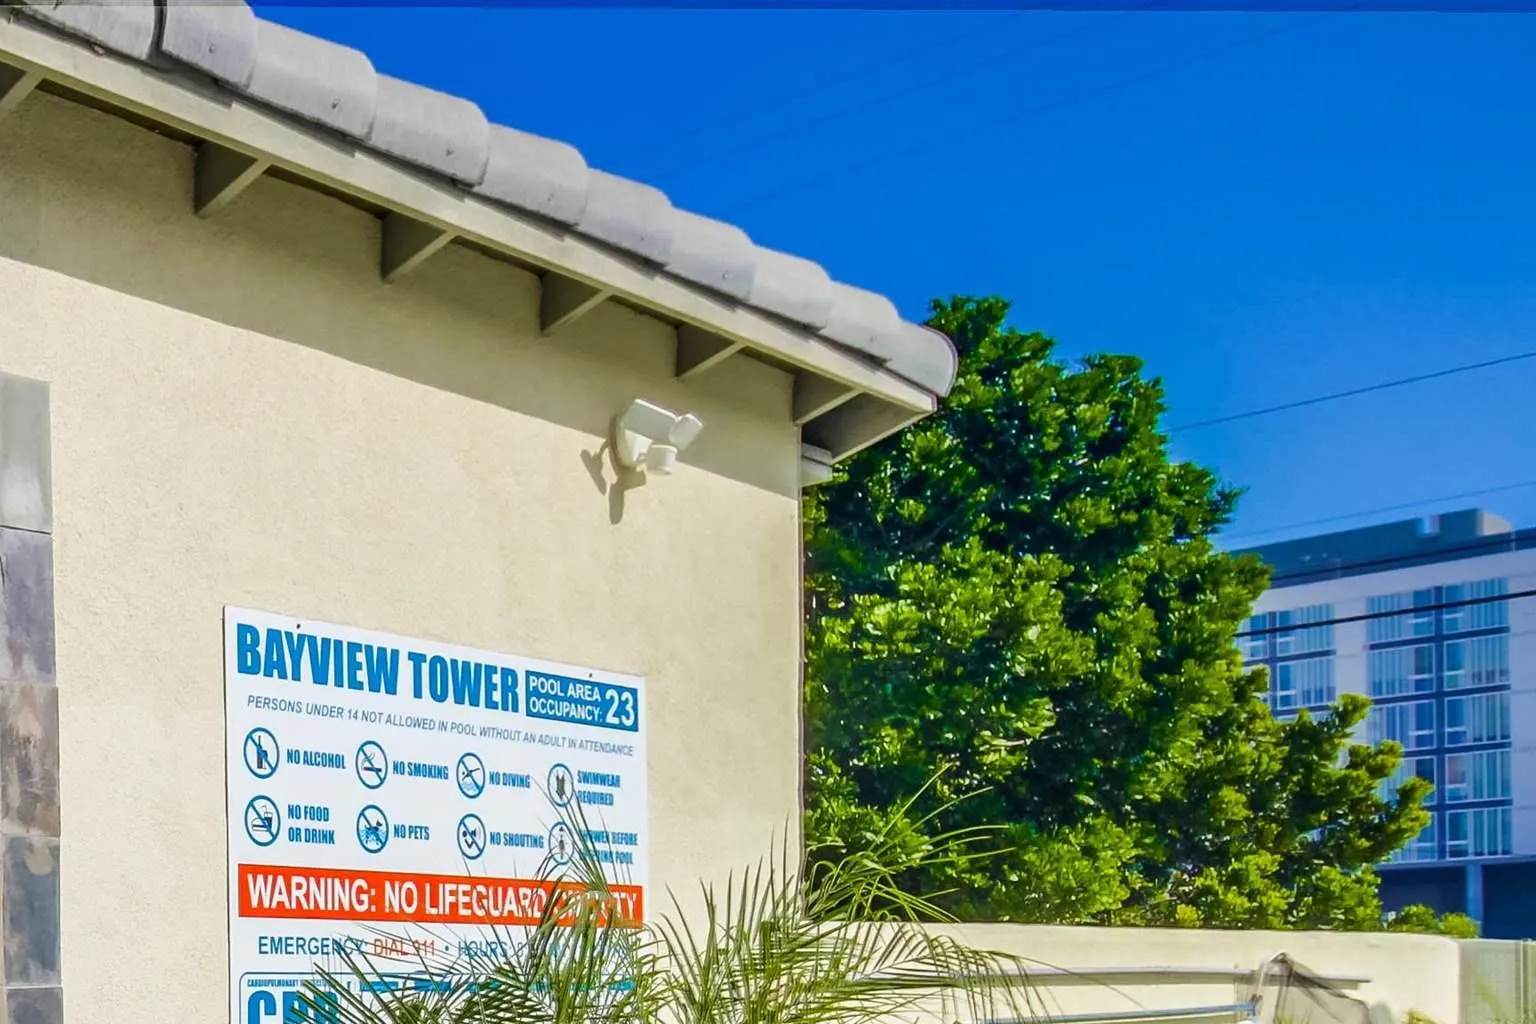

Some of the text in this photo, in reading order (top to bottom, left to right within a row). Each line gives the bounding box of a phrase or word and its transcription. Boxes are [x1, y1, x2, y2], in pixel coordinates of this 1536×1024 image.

[237, 623, 519, 713] BAYVIEW TOWER
[529, 675, 601, 702] POOL AREA
[530, 698, 603, 722] OCCUPANCY:
[605, 688, 635, 727] 23
[247, 694, 633, 757] PERSONS UNDER 14 NOT ALLOWED IN POOL WITHOUT AN ADULT IN ATTENDANCE
[287, 748, 346, 769] NO ALCOHOL
[393, 760, 449, 780] NO SMOKING
[489, 771, 530, 788] NO DIVING
[577, 770, 621, 788] SWIMWEAR
[288, 804, 329, 822] NO FOOD
[288, 827, 335, 844] OR DRINK
[394, 824, 430, 840] NO PETS
[490, 831, 544, 849] NO SHOUTING
[247, 874, 376, 913] WARNING:
[384, 880, 418, 915] NO
[425, 882, 547, 918] LIFEGUARD
[374, 938, 409, 957] DIAL
